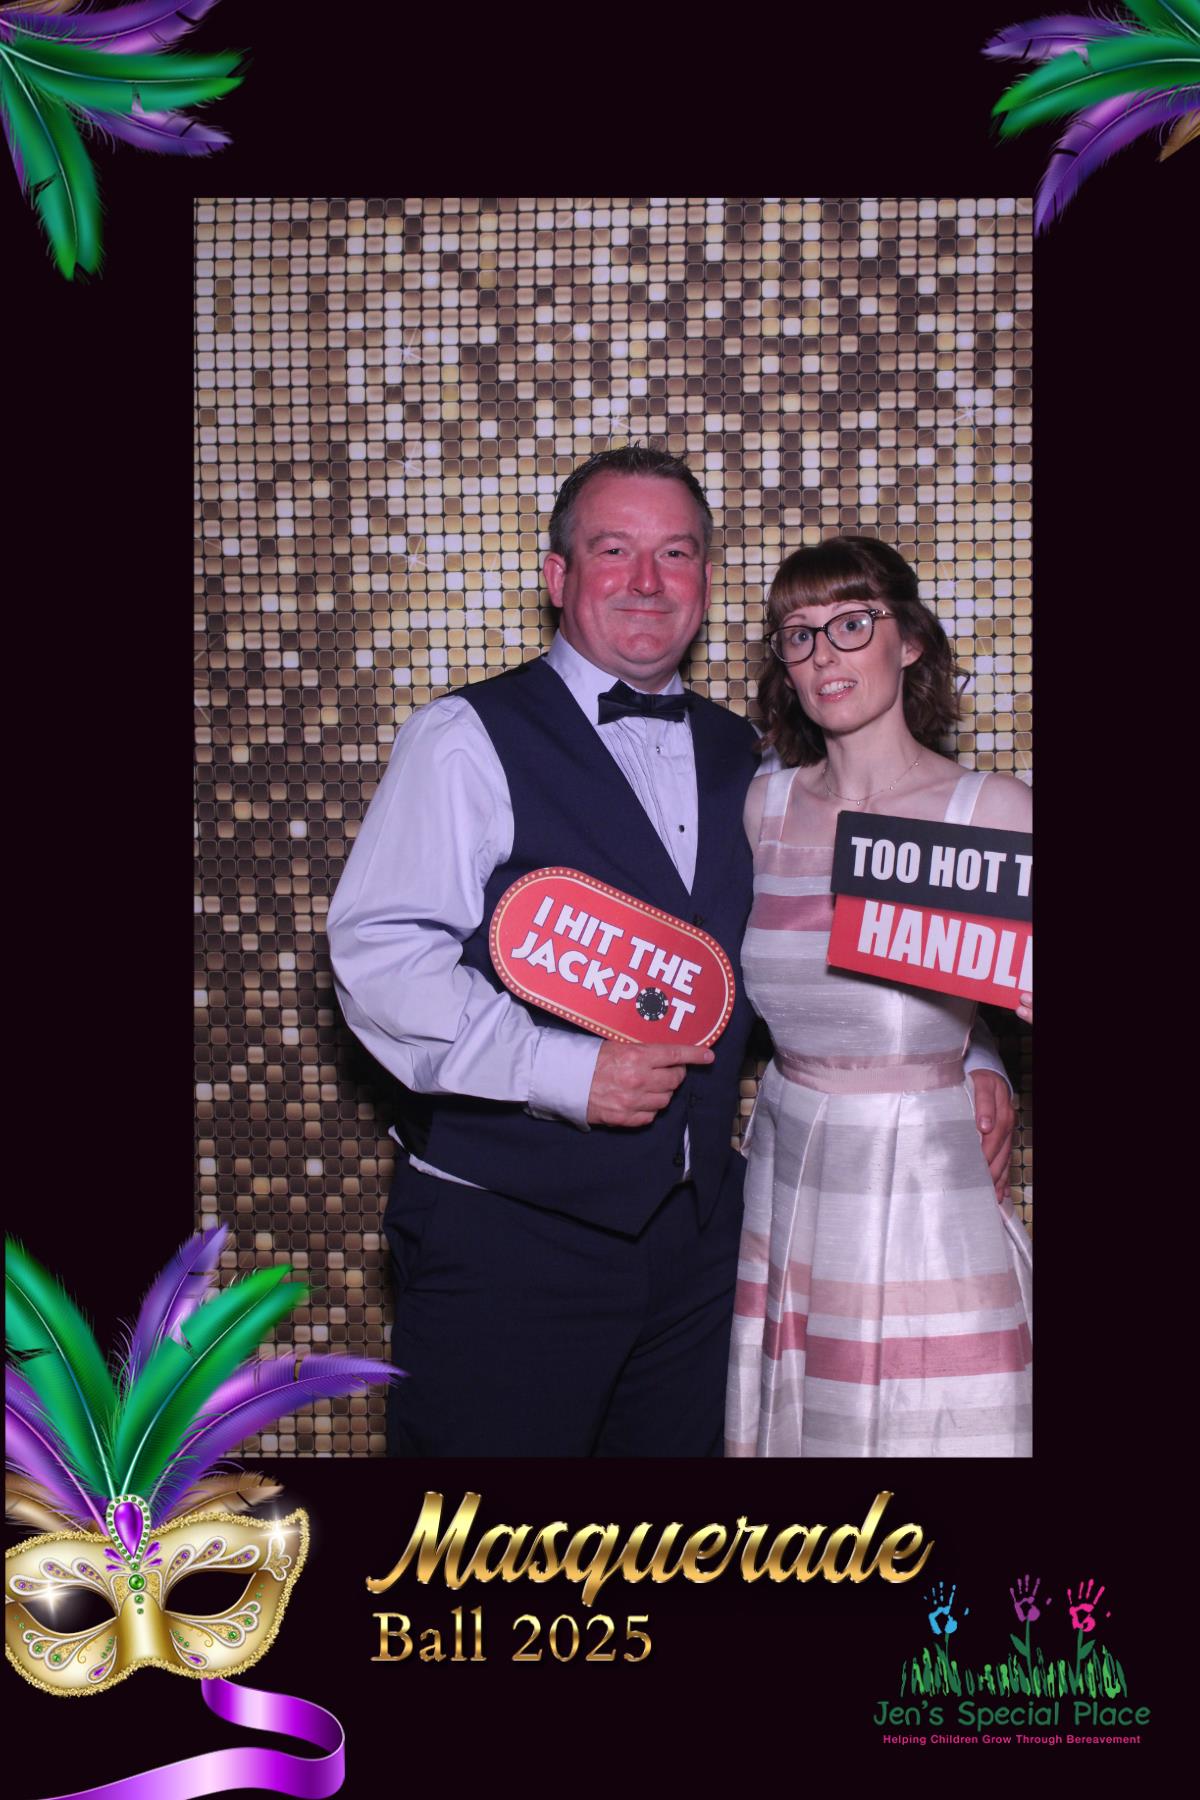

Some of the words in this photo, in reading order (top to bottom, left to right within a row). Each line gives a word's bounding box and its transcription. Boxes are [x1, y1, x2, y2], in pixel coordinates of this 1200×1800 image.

[851, 836, 921, 884] TOO
[929, 845, 1007, 894] HOT
[511, 930, 696, 1032] JACKPOT
[533, 896, 554, 927] I
[553, 904, 624, 956] HIT
[629, 936, 702, 996] THE
